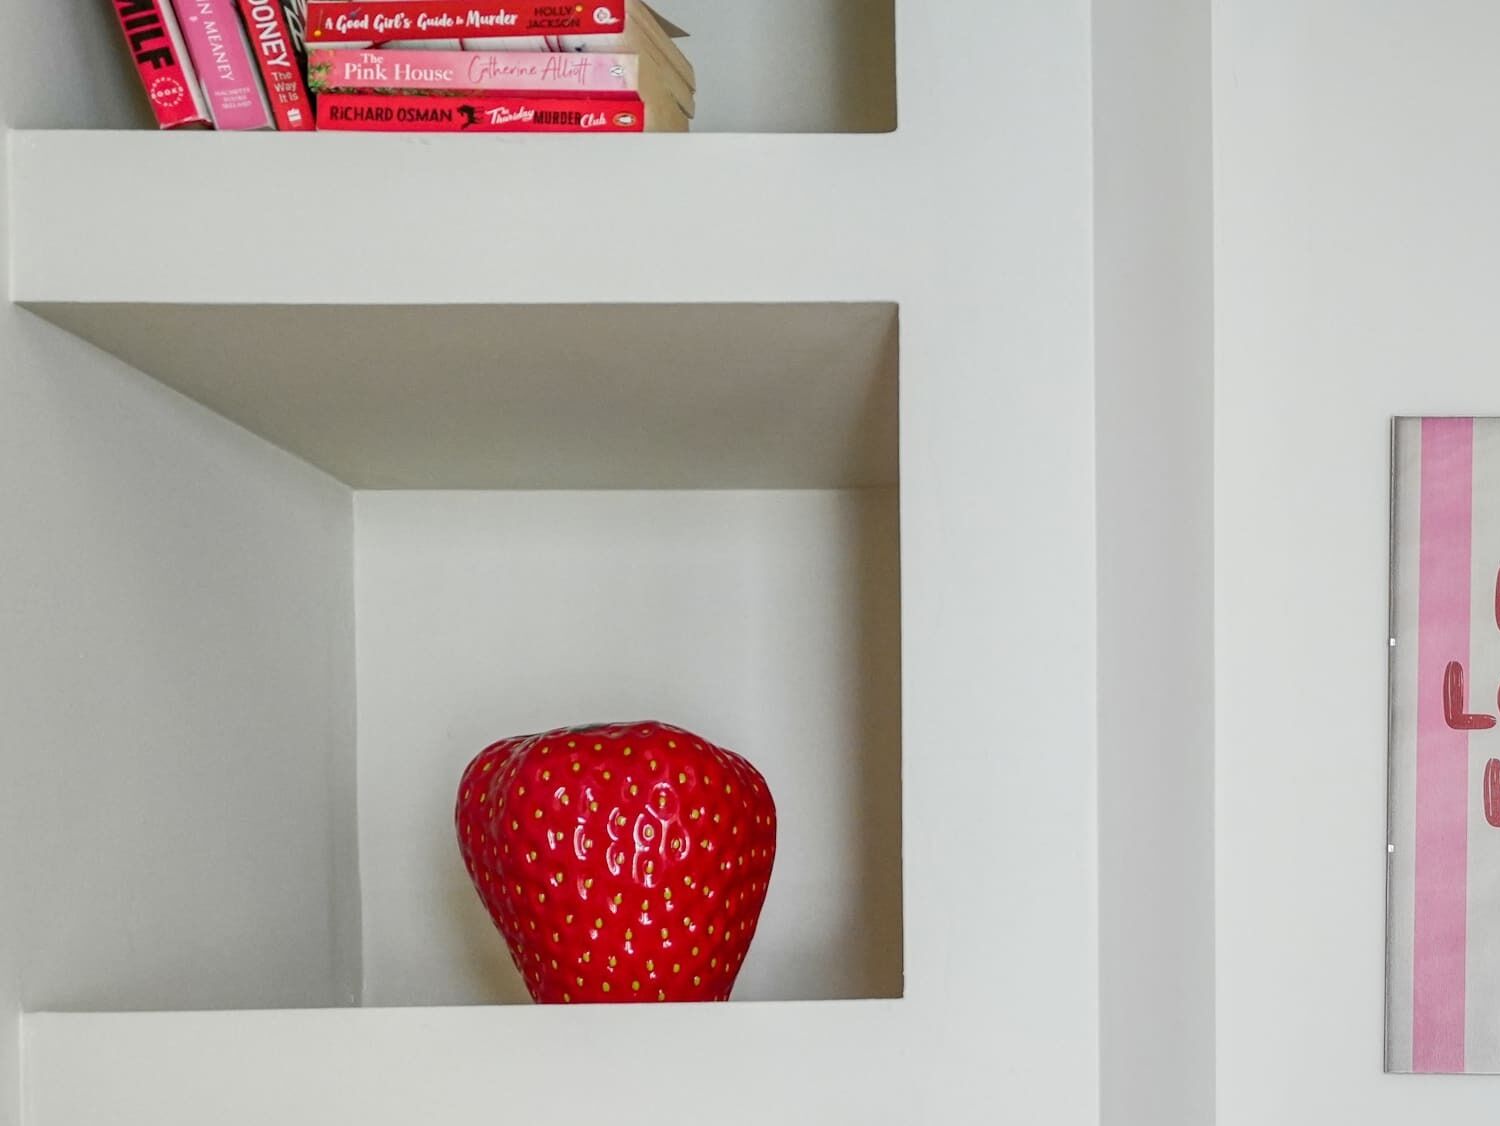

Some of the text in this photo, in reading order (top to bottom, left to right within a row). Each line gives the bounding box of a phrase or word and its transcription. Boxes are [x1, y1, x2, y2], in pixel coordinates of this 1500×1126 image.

[534, 6, 573, 17] HOLLY
[325, 17, 333, 30] A
[336, 14, 369, 34] Good
[373, 12, 412, 33] Girl's
[417, 12, 454, 31] Guide
[466, 9, 519, 28] Murder
[526, 18, 581, 29] JACKSON
[203, 21, 235, 80] MEANEY
[360, 53, 384, 64] The
[271, 71, 292, 81] The
[344, 63, 454, 81] Pink House
[467, 55, 537, 84] Catherine
[274, 81, 297, 93] Way
[397, 108, 453, 122] OSMAN
[486, 106, 535, 125] Thursday
[533, 111, 582, 125] MURDER
[580, 113, 607, 128] Club
